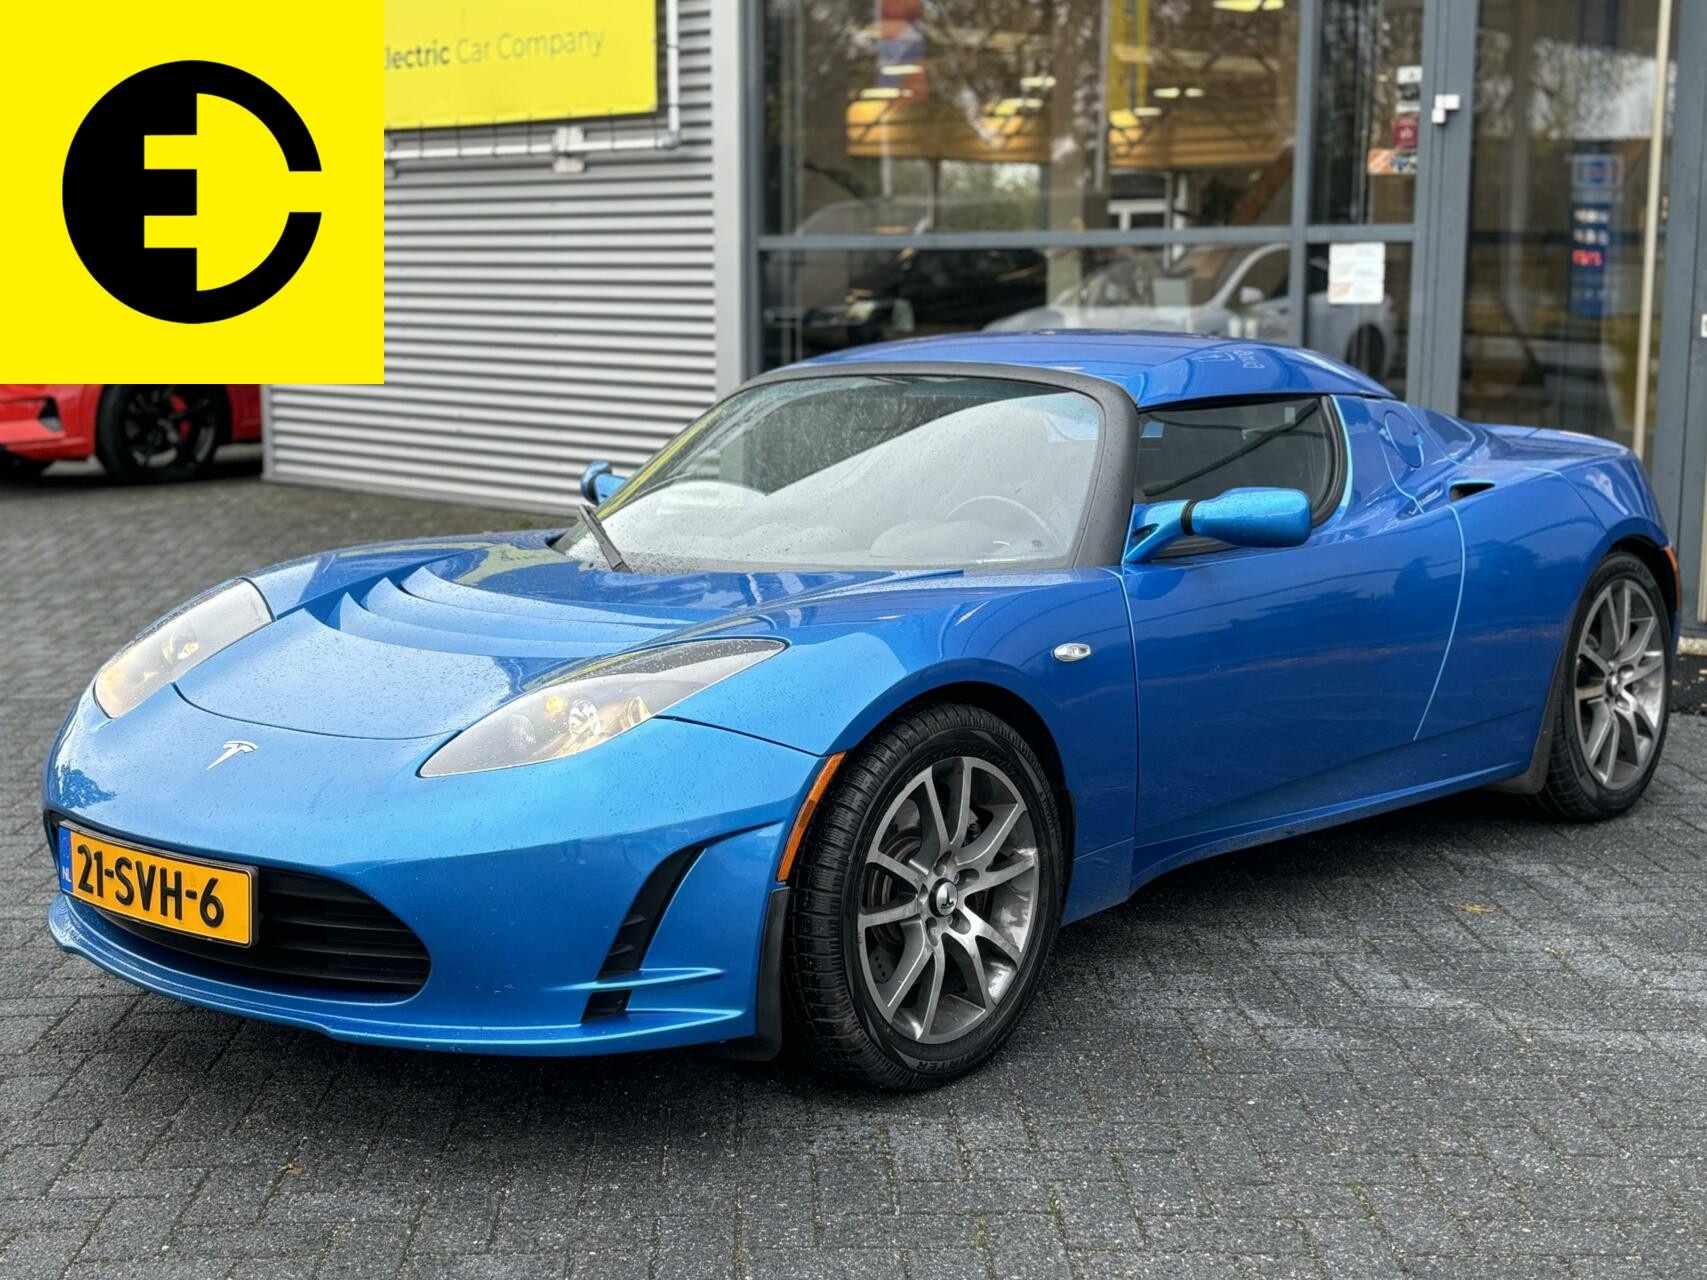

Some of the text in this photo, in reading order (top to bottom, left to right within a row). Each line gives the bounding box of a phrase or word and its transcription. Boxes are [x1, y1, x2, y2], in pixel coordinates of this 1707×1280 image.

[383, 26, 606, 71] lectric Car Company
[62, 865, 72, 883] NL
[77, 843, 224, 928] 21-SVH-6
